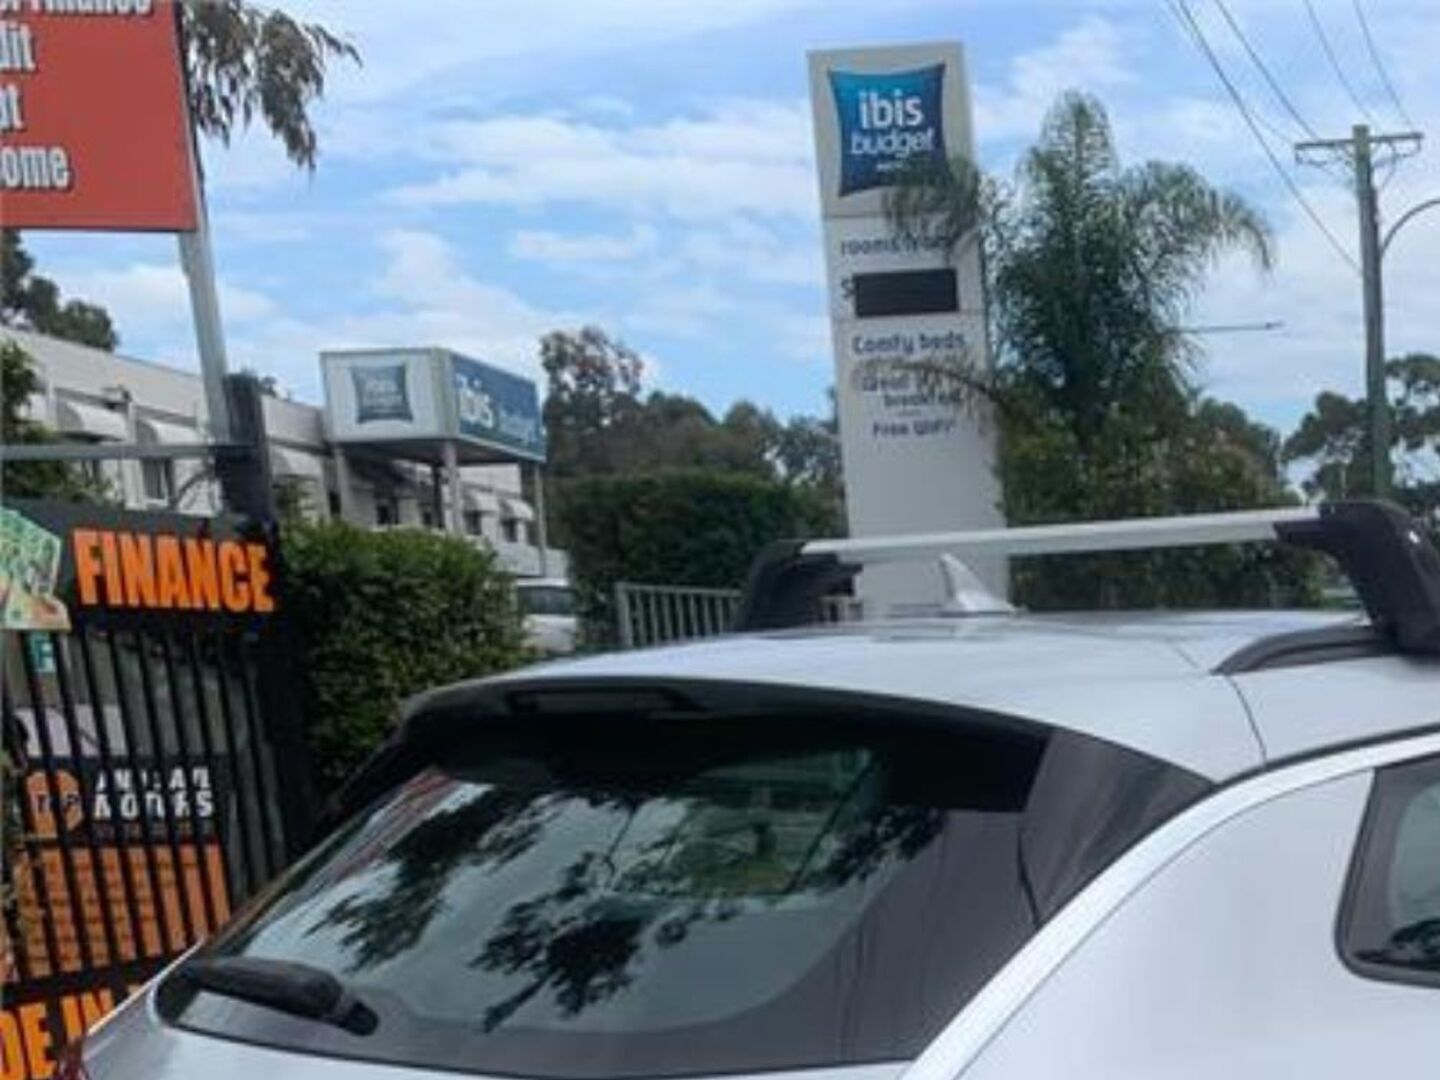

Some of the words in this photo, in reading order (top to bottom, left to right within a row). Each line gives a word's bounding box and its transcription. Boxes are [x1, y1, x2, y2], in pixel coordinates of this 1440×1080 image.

[857, 89, 924, 130] ibis
[851, 128, 935, 159] budget
[855, 333, 915, 355] Comfy
[920, 332, 966, 350] beds
[73, 527, 275, 613] FINANCE
